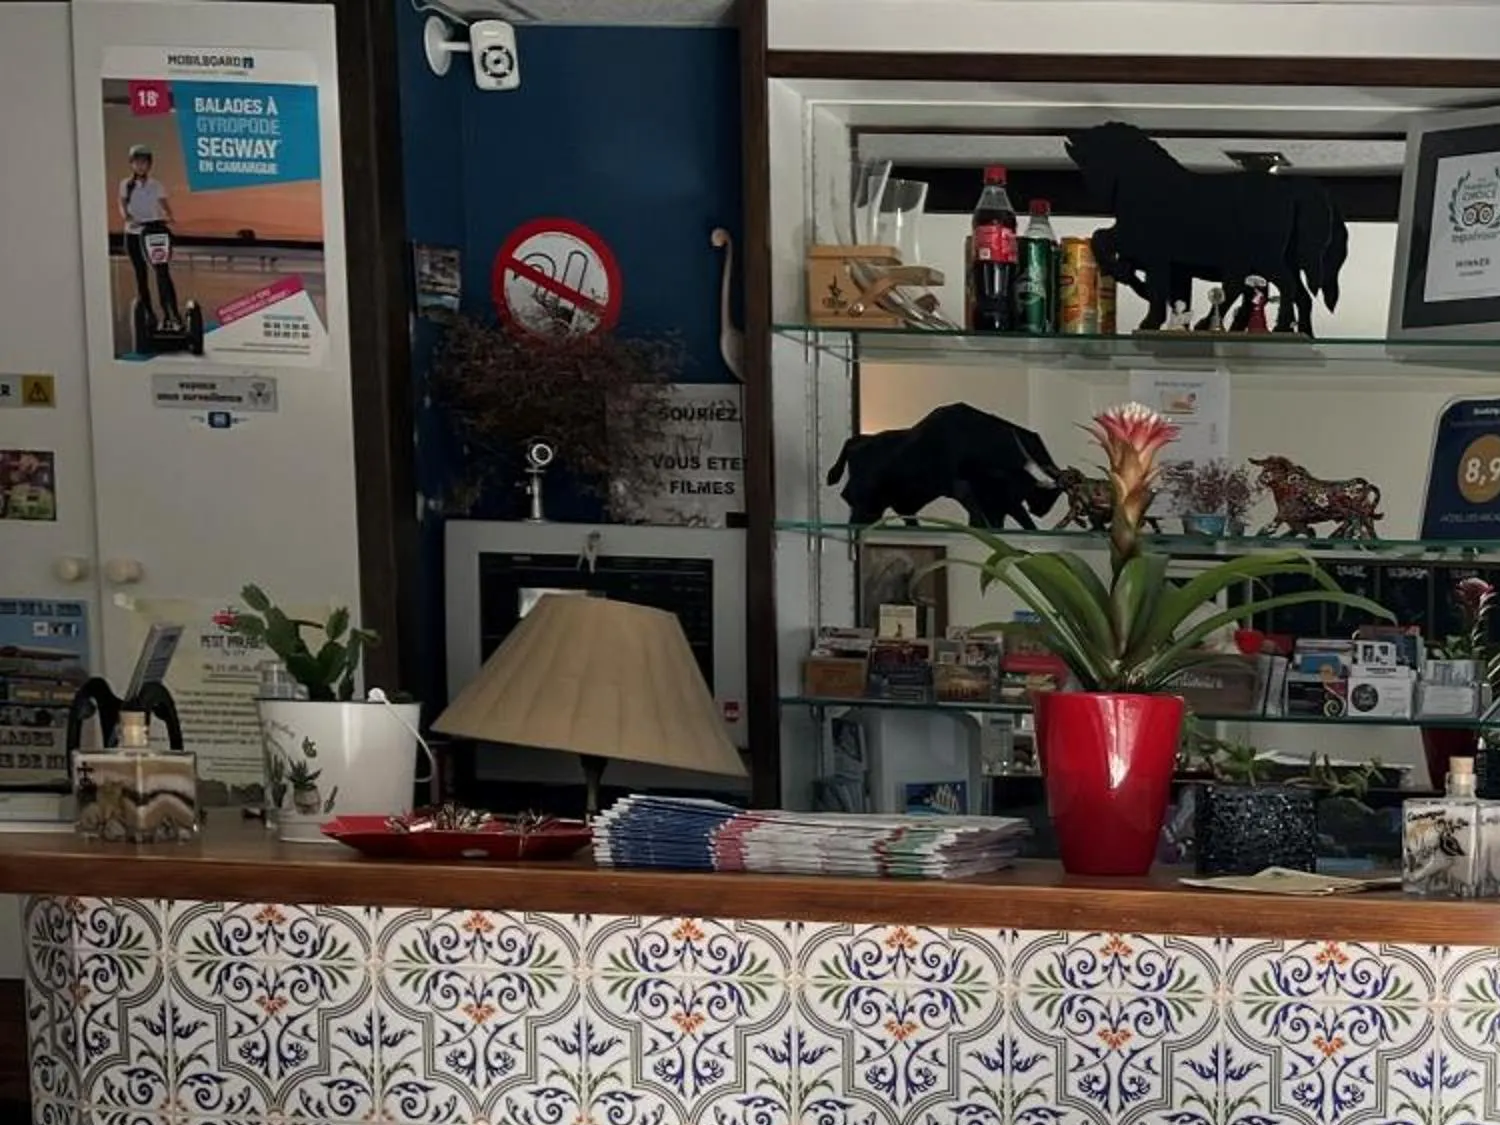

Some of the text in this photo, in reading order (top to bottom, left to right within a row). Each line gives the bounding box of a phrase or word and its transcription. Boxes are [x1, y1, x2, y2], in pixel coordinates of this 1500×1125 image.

[168, 54, 240, 66] MOBILBOARD
[195, 95, 278, 115] BALADES À
[197, 117, 280, 134] GYROPODE
[197, 138, 278, 159] SEGWAY
[200, 159, 278, 175] EN CAMARGUE
[707, 457, 747, 471] ETE
[669, 481, 736, 496] FILMES
